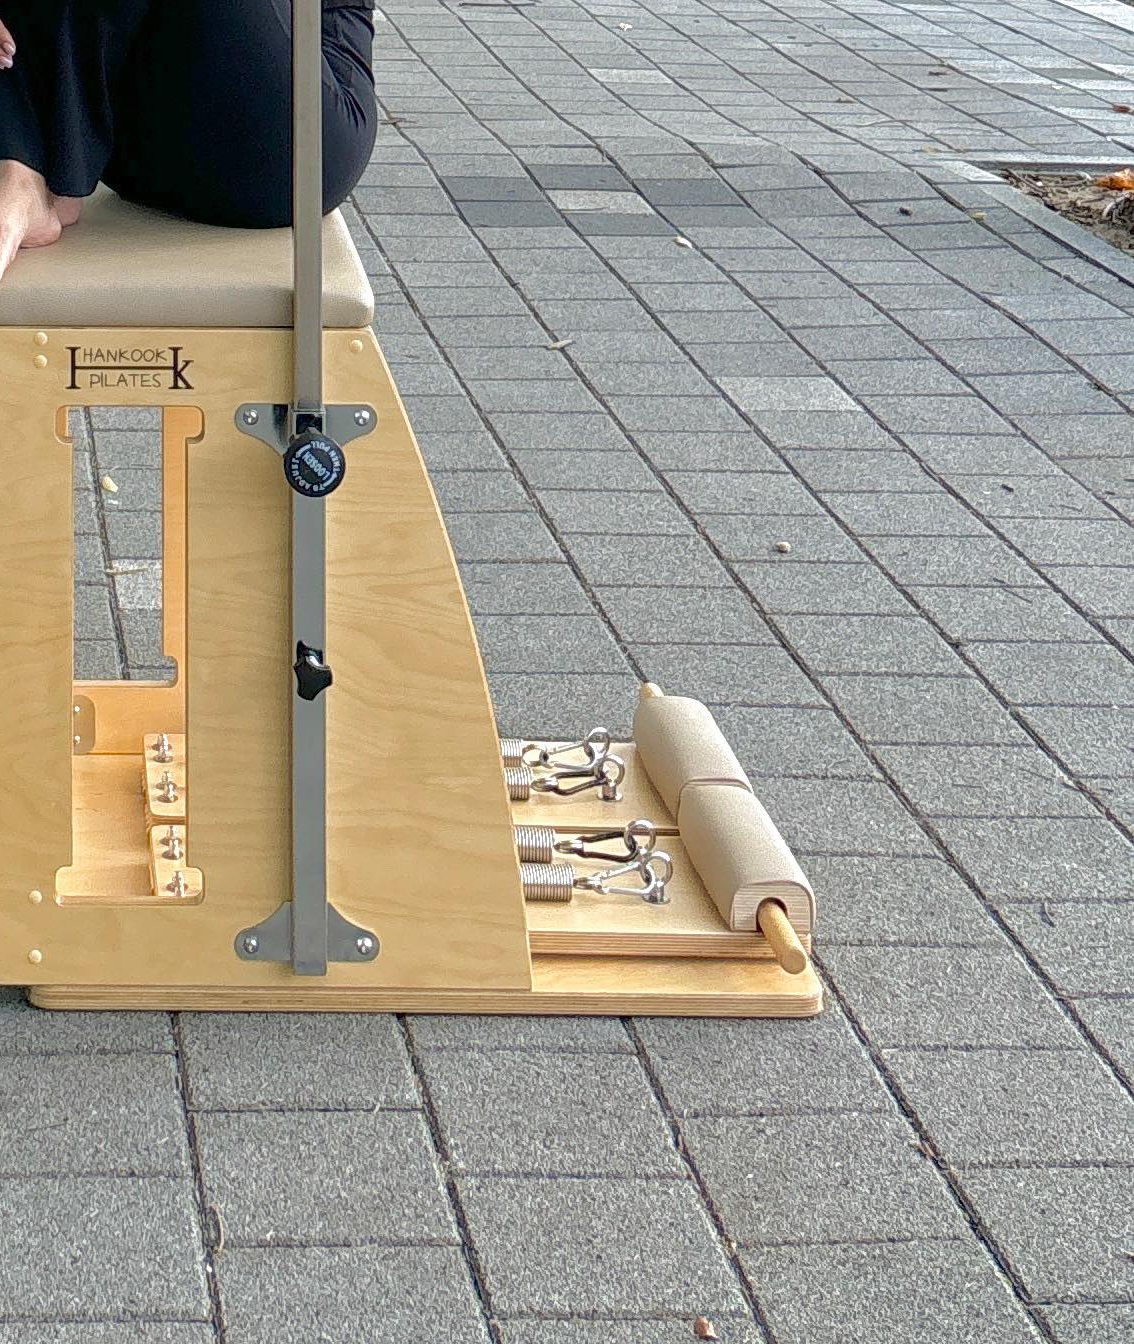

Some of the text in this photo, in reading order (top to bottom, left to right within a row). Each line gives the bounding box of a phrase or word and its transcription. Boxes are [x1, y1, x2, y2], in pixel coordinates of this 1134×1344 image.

[82, 347, 168, 363] HANKOOK
[89, 372, 162, 388] PILATES
[310, 440, 331, 453] PULL
[302, 451, 331, 481] LOOSEN
[312, 482, 326, 492] TO
